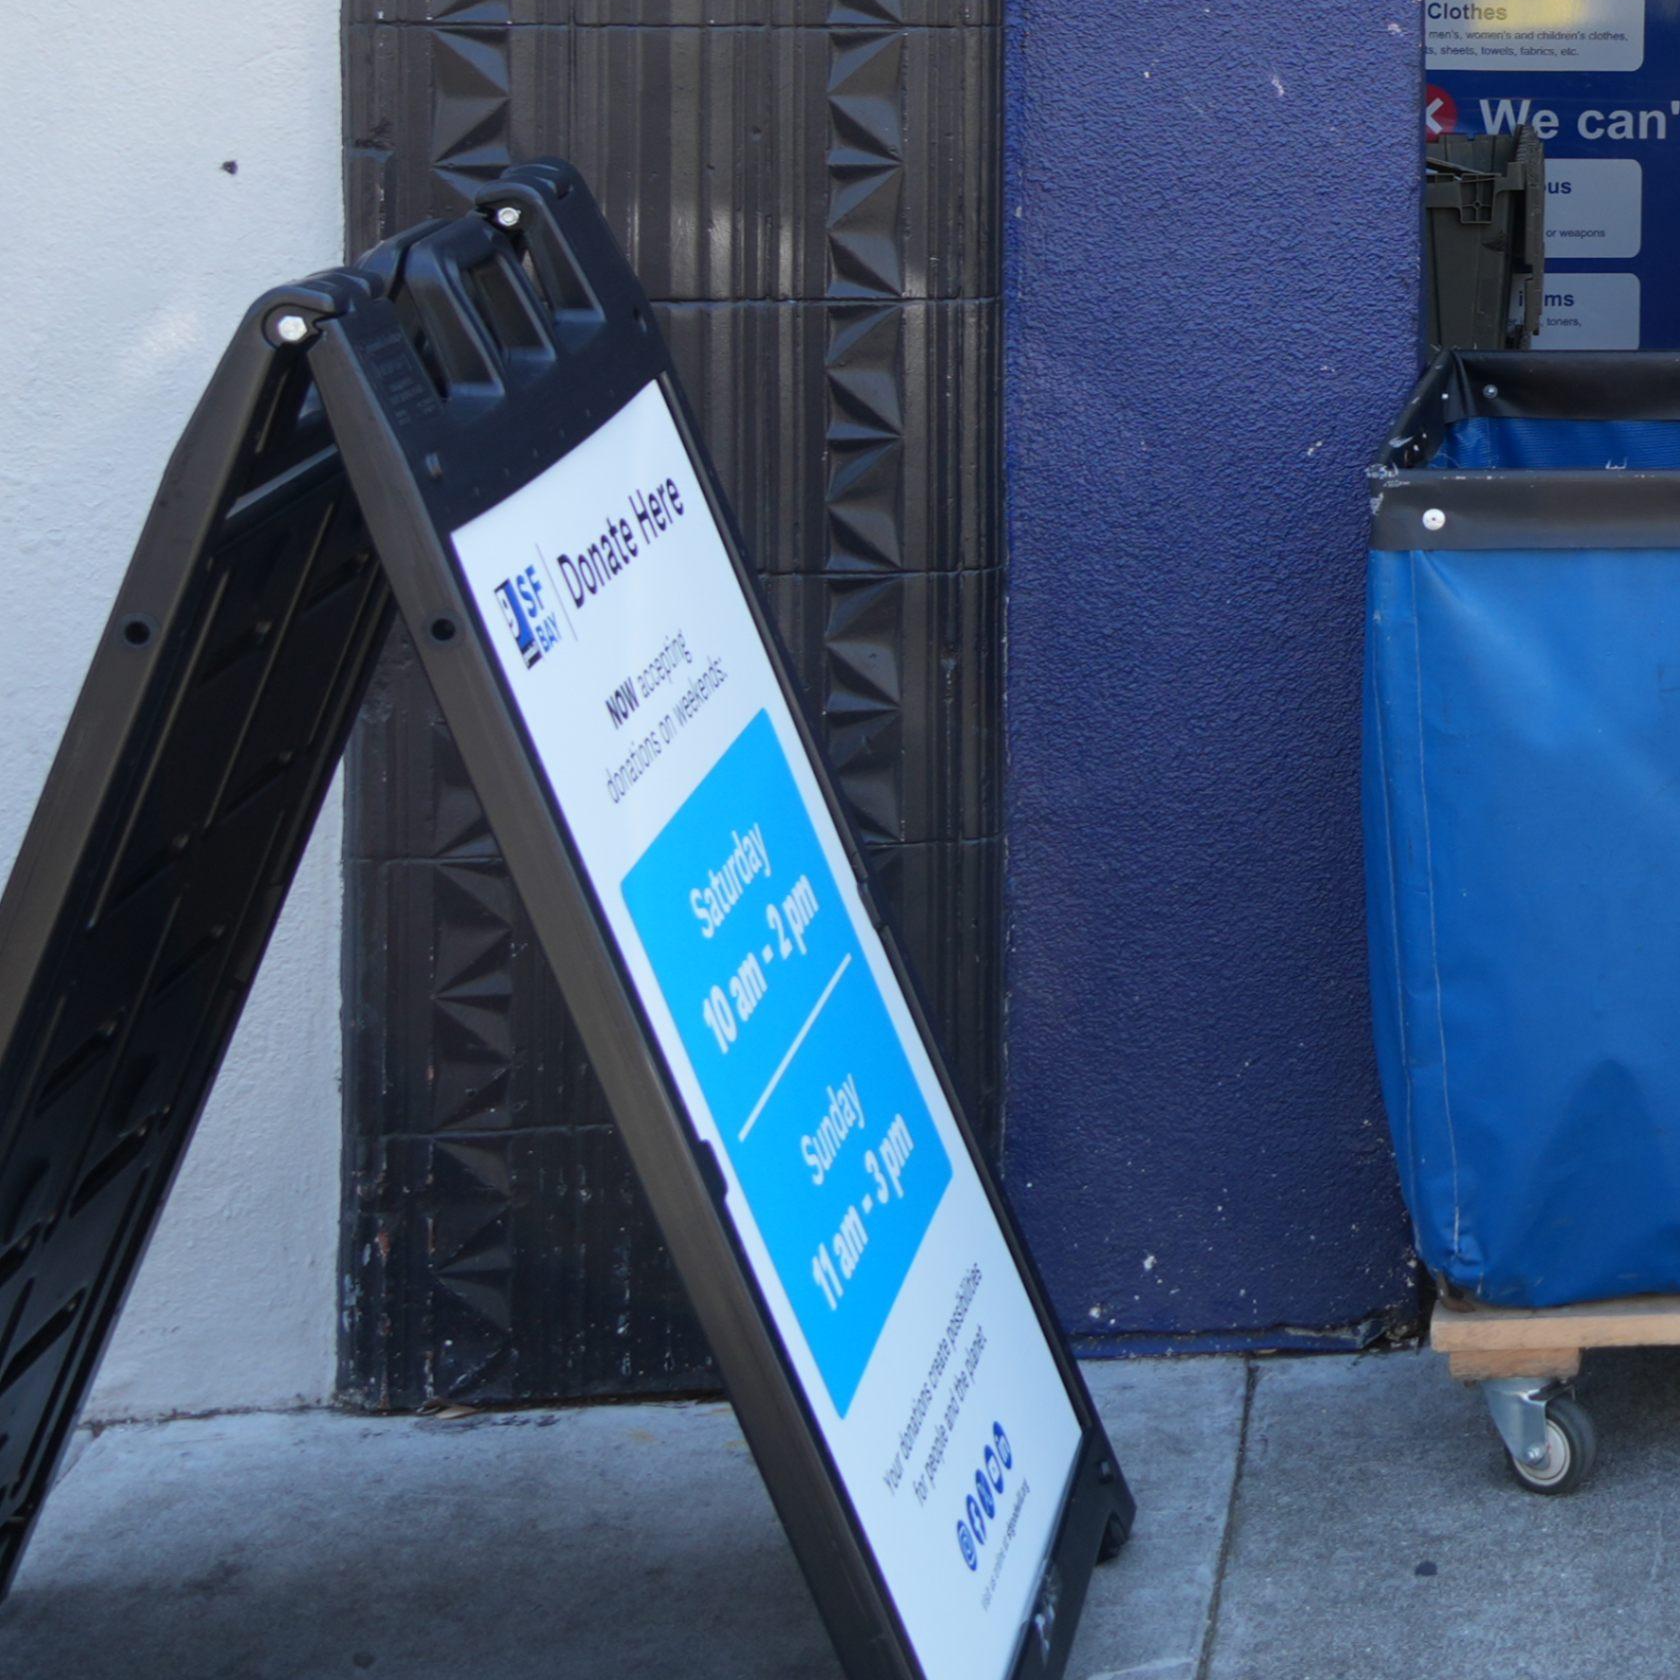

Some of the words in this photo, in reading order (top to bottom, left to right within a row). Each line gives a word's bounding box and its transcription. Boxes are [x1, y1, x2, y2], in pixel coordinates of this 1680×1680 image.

[1428, 2, 1508, 21] Clothes
[1466, 31, 1512, 41] women's
[1515, 31, 1534, 41] and
[1537, 30, 1585, 41] children's
[1479, 98, 1560, 140] We
[1546, 230, 1557, 238] or
[1559, 229, 1605, 241] weapons
[516, 564, 545, 619] SF
[557, 516, 639, 610] Donate
[628, 477, 684, 546] Here
[535, 612, 562, 654] BAY
[605, 676, 640, 731] NOW
[637, 628, 693, 699] accepting
[606, 731, 662, 805] donations
[659, 714, 678, 745] on
[690, 822, 771, 940] Saturday
[703, 984, 739, 1057] 10
[729, 951, 768, 1023] am
[766, 903, 793, 960] 2
[781, 874, 820, 956] pm
[802, 1072, 866, 1187] Sunday
[812, 1243, 844, 1312] 11
[833, 1204, 870, 1281] am
[864, 1149, 890, 1205] 3
[878, 1113, 915, 1200] pm
[882, 1452, 904, 1497] Your
[898, 1381, 933, 1461] donations
[927, 1337, 951, 1389] create
[946, 1262, 983, 1350] possibilities
[912, 1479, 928, 1508] for
[924, 1423, 949, 1491] people
[944, 1387, 961, 1433] and
[953, 1369, 971, 1401] the
[965, 1323, 988, 1388] planet
